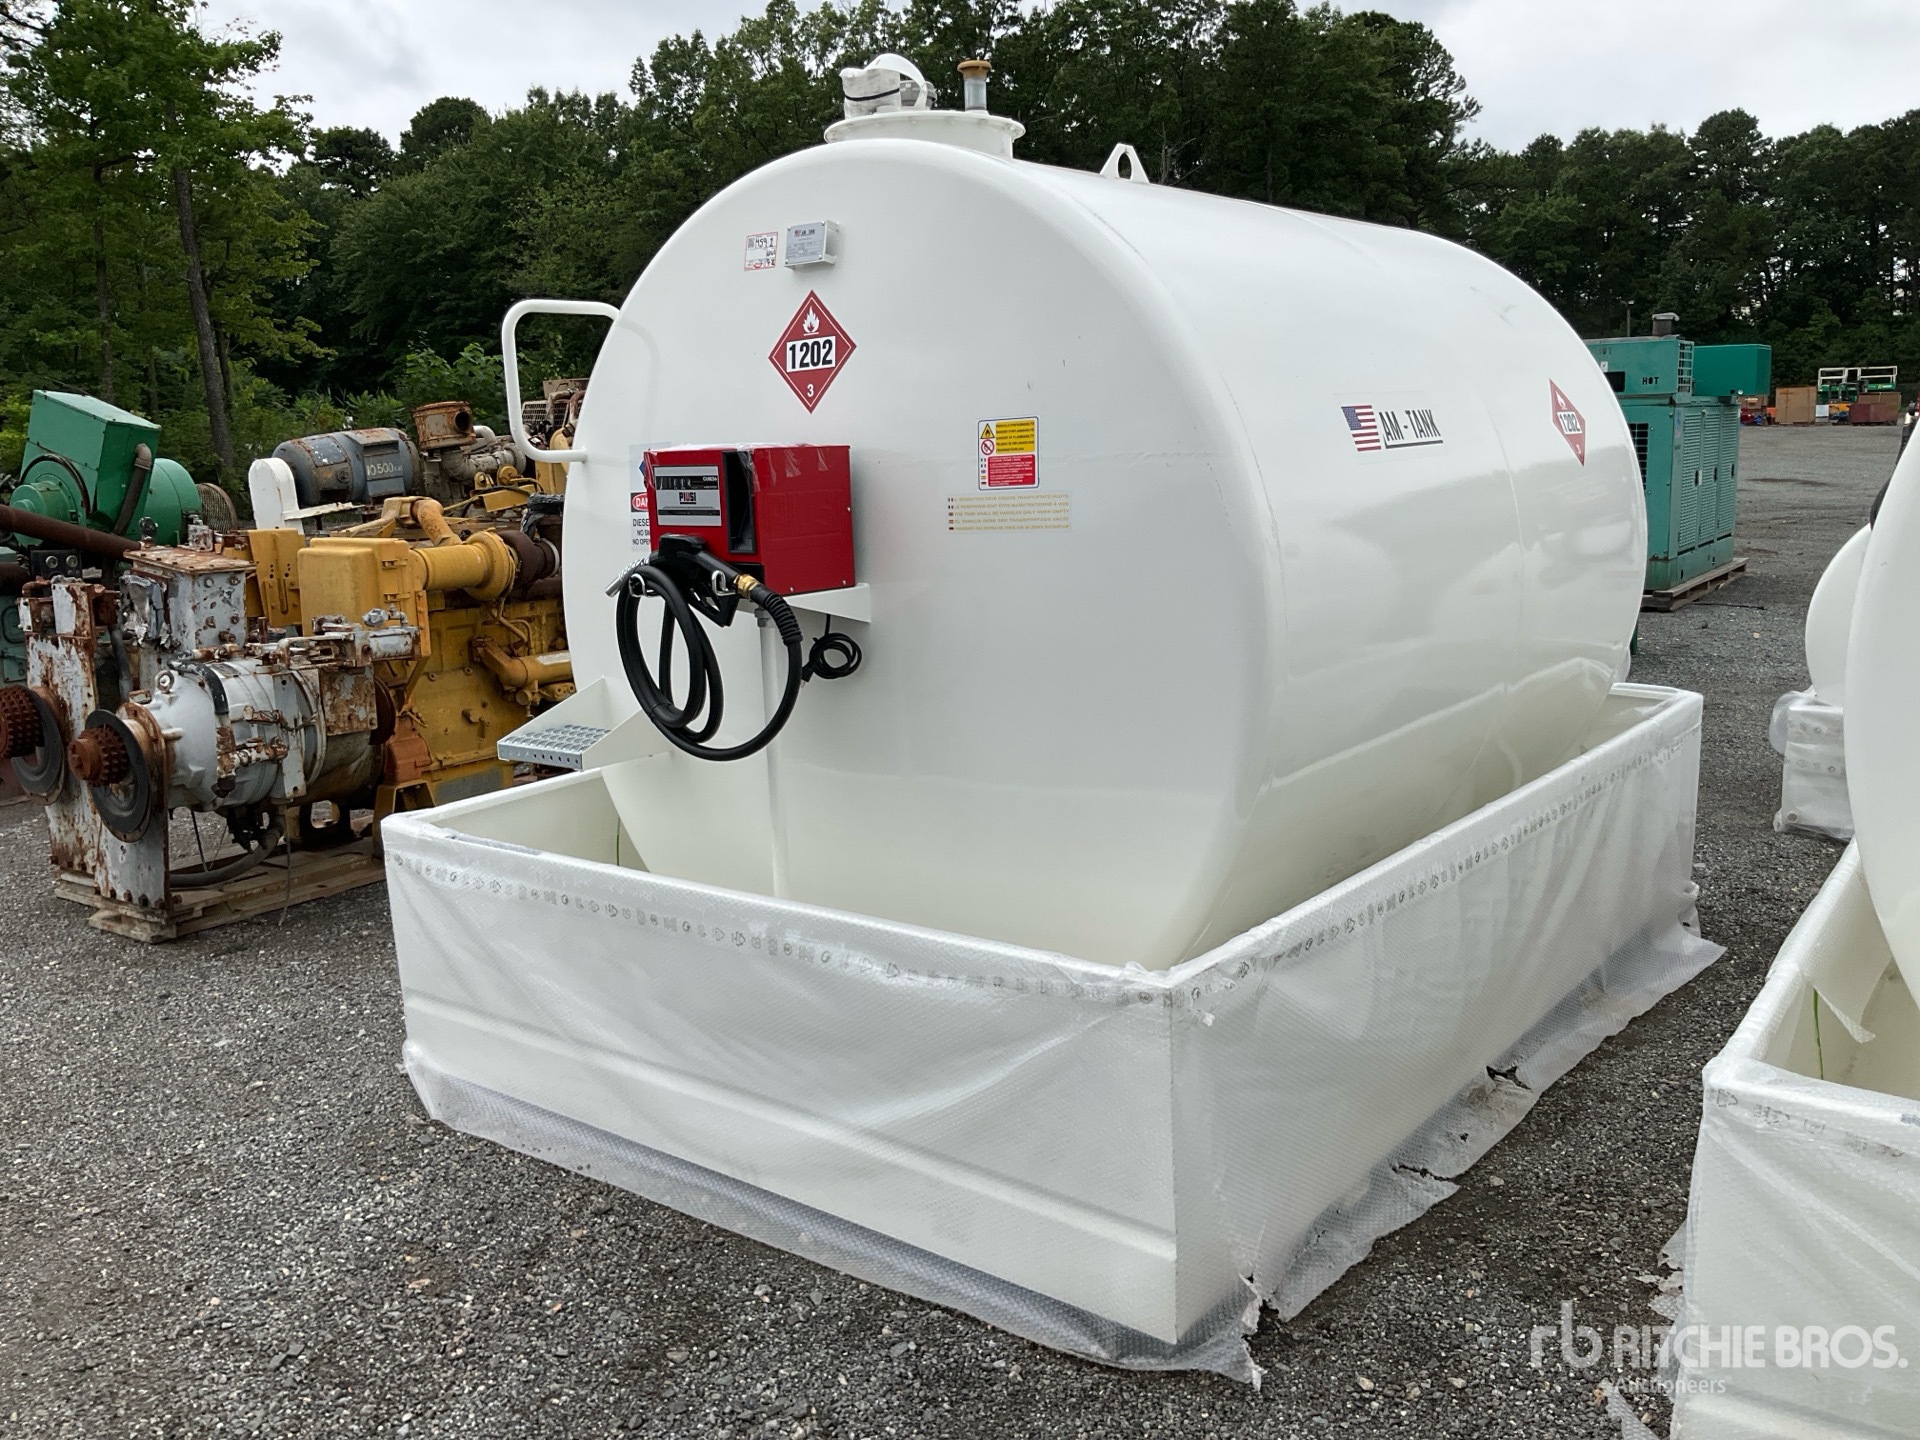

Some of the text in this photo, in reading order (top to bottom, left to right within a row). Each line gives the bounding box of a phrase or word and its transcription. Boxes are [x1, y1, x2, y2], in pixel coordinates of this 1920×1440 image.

[789, 339, 833, 369] 1202
[1642, 377, 1659, 385] HOT
[807, 384, 814, 397] 3
[1379, 411, 1404, 441] AM
[1405, 409, 1441, 439] TANK
[1559, 413, 1581, 432] 1202
[679, 492, 697, 502] PIUSI
